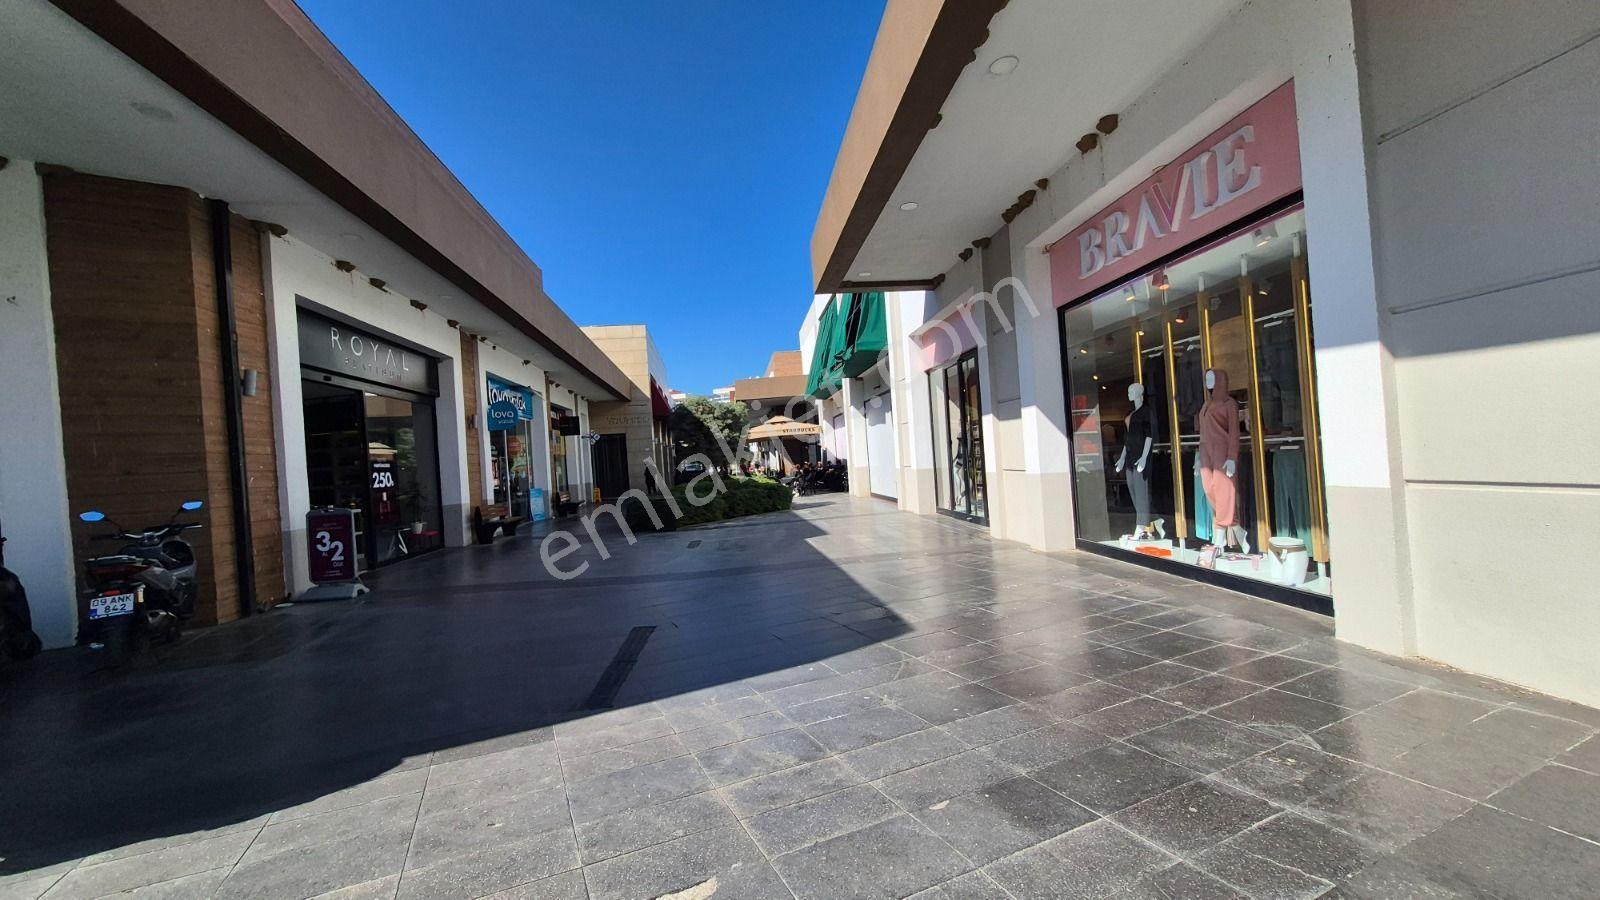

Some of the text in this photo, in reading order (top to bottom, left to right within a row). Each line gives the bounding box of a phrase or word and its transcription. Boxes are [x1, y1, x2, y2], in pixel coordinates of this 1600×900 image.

[1077, 125, 1262, 279] BRAVIE
[330, 327, 409, 371] ROYAL
[491, 409, 514, 419] lova
[315, 531, 331, 552] 3
[330, 541, 345, 561] 2
[92, 595, 132, 607] 09 ANK
[104, 604, 126, 613] 842
